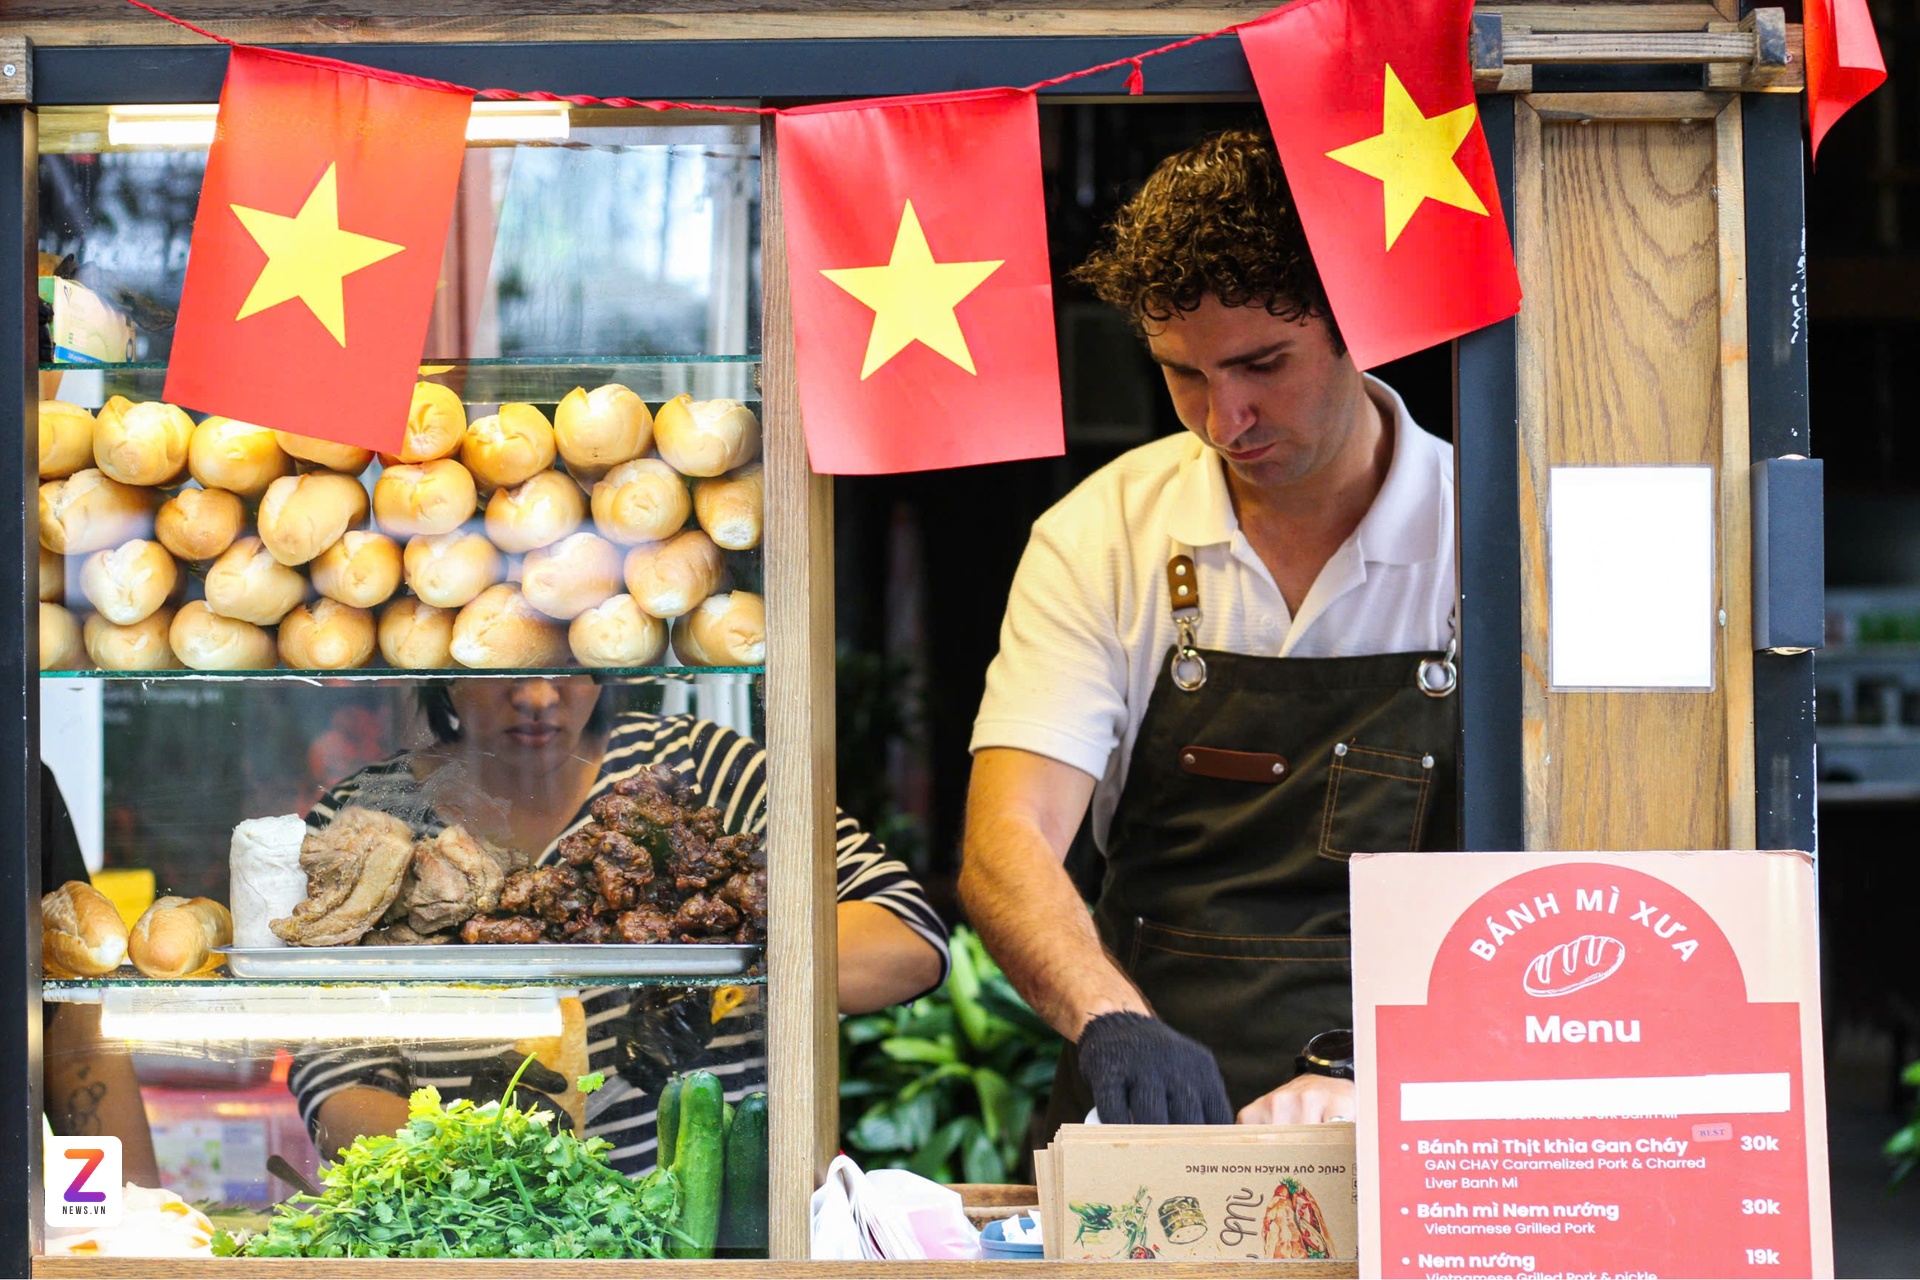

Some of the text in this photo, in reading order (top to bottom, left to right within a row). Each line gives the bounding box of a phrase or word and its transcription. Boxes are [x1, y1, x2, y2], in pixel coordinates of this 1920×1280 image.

[1469, 885, 1700, 962] BÁNH MÌ XƯA
[1525, 1015, 1641, 1043] Menu
[1699, 1128, 1725, 1138] BEST
[1417, 1136, 1689, 1157] Bánh mì Thịt khìa Gan Cháy
[1740, 1135, 1780, 1151] 30k
[1222, 1165, 1252, 1173] NGON
[1255, 1165, 1290, 1175] KHÁCH
[1293, 1164, 1315, 1175] QUÝ
[1318, 1165, 1346, 1175] CHÚC
[1424, 1156, 1706, 1171] GAN CHAY Caramelized Pork & Charred
[1425, 1177, 1458, 1189] Liver
[1461, 1176, 1499, 1189] Banh
[1417, 1201, 1620, 1222] Bánh mì Nem nướng
[1741, 1198, 1781, 1215] 30k
[1424, 1222, 1596, 1235] Vietnamese Grilled Pork
[1418, 1252, 1536, 1272] Nem nướng
[1745, 1248, 1780, 1265] 19k
